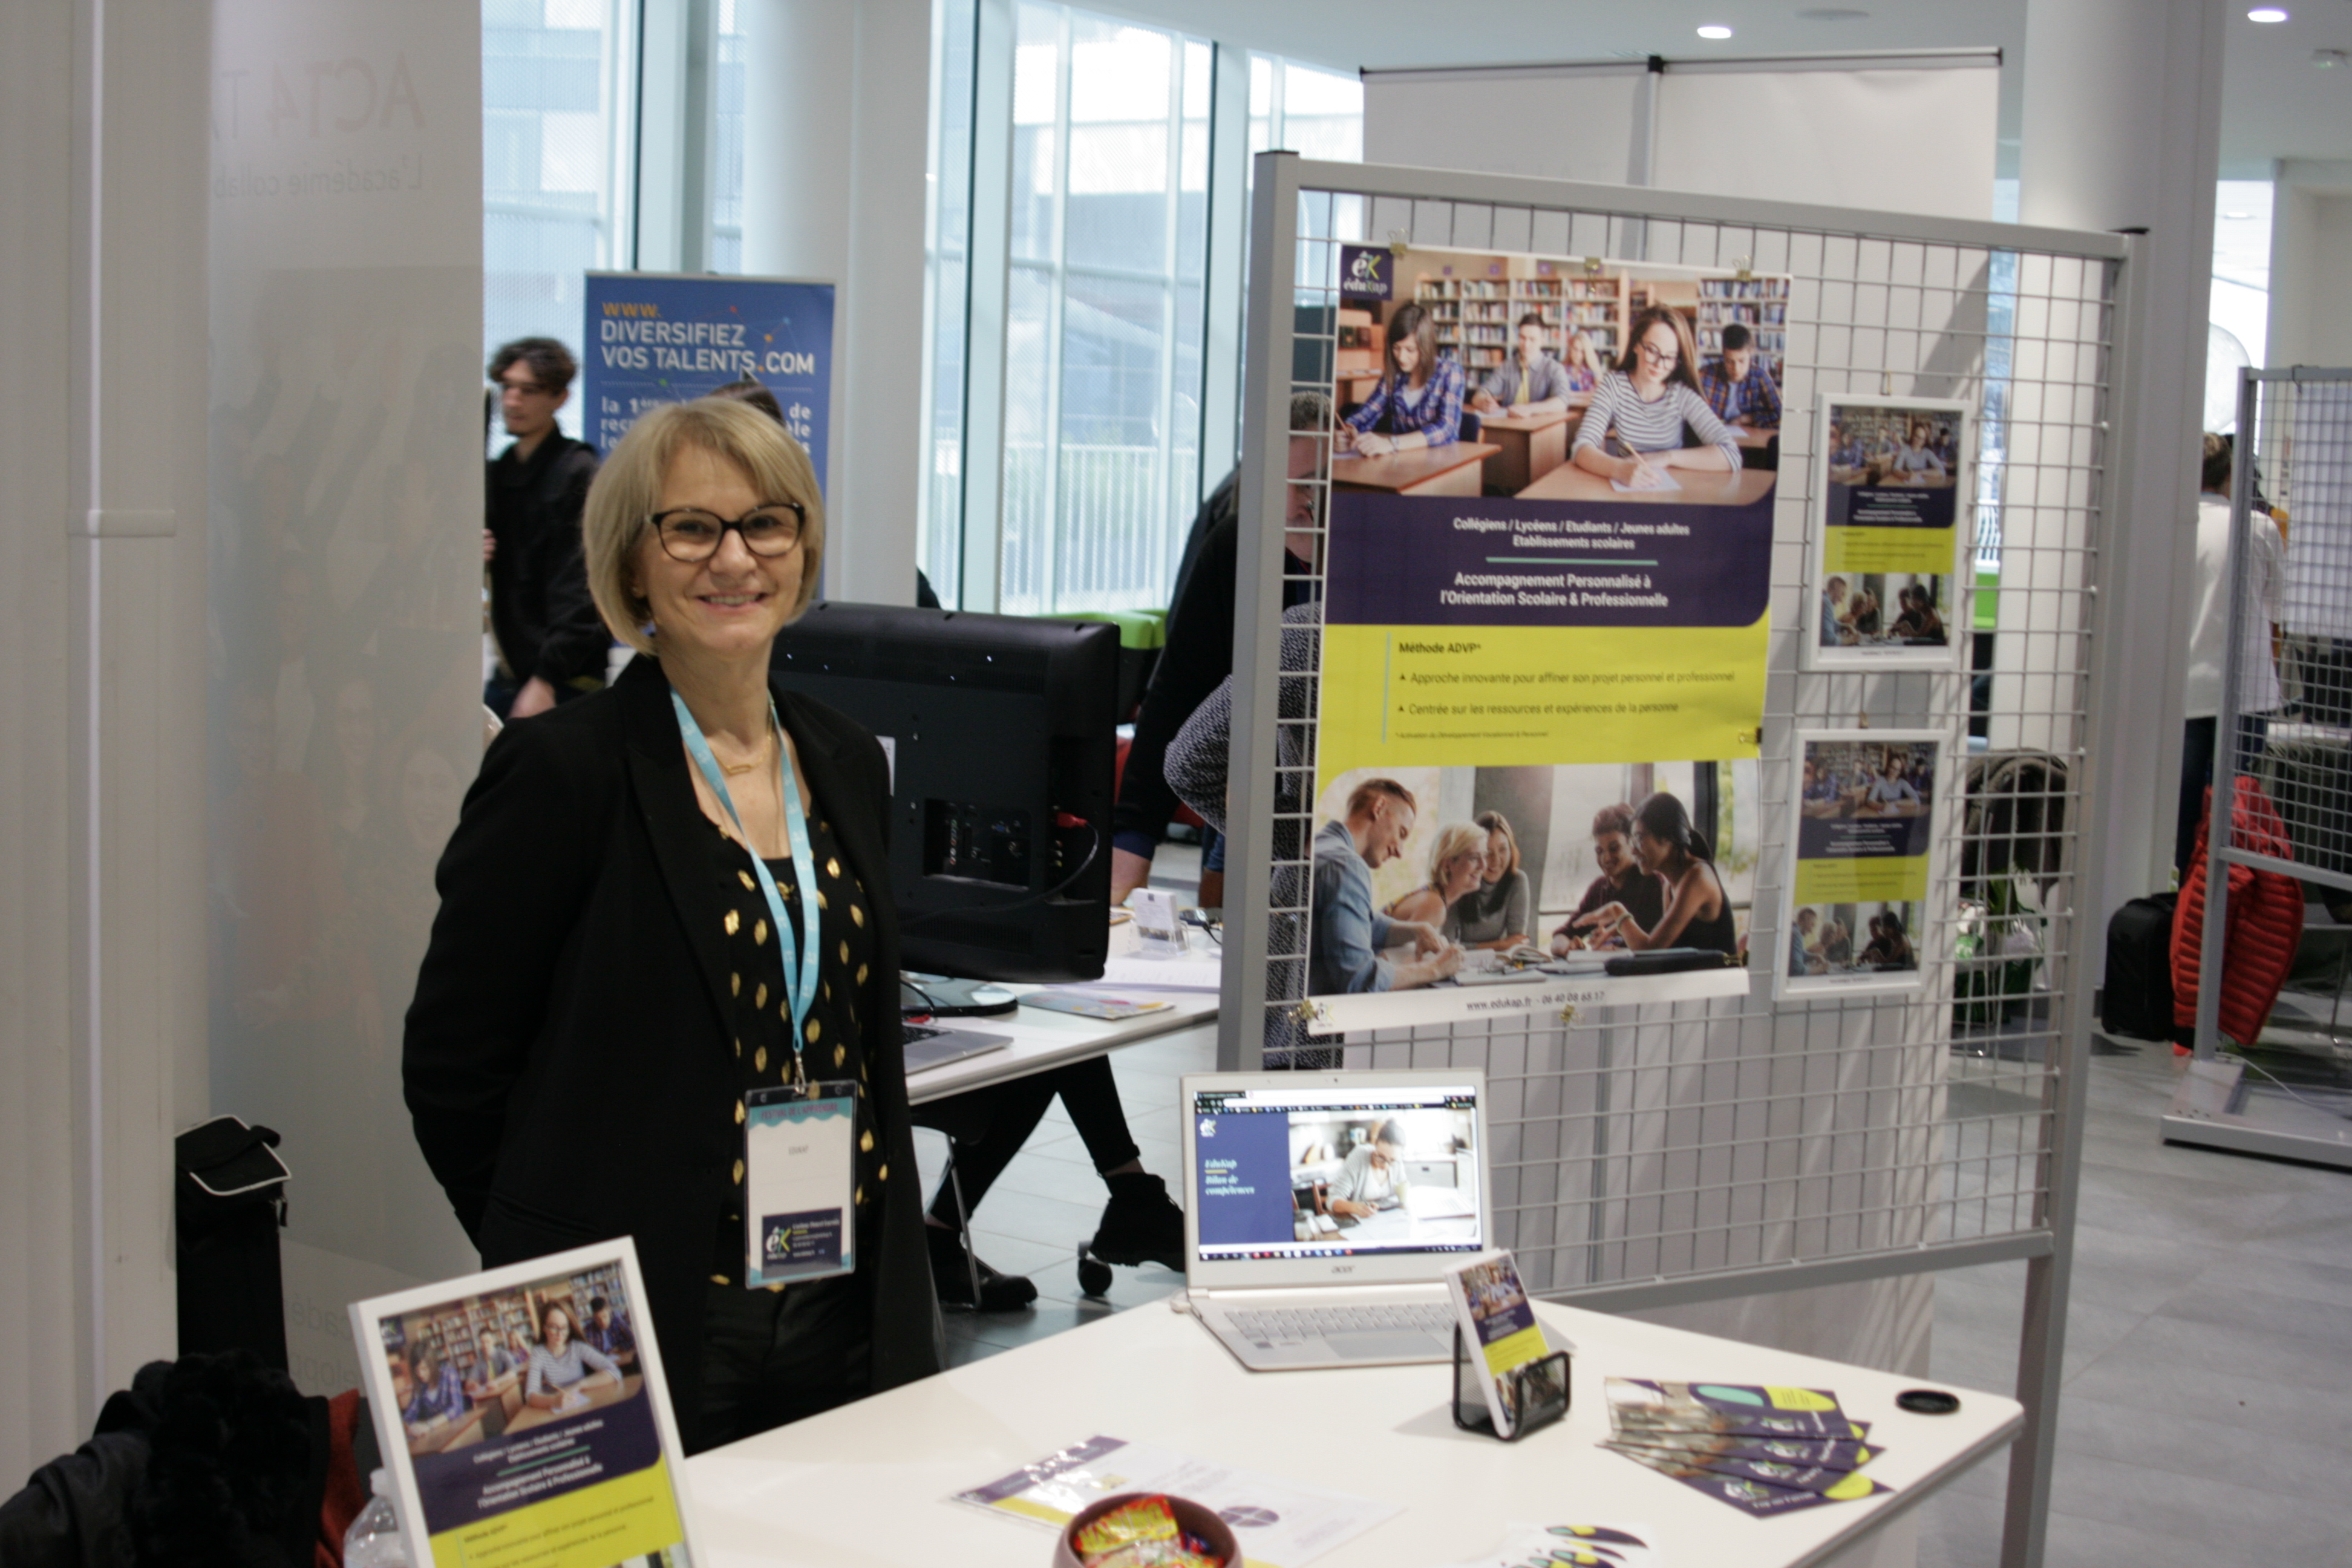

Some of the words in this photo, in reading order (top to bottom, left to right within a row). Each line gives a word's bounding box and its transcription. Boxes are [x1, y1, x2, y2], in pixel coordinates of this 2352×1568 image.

[601, 319, 746, 347] DIVERSIFIEZ
[601, 345, 648, 370] VOS
[601, 396, 621, 414] la
[788, 402, 812, 420] de
[1453, 517, 1508, 533] Collégiens
[1515, 518, 1558, 534] Lycéens
[1566, 520, 1613, 534] Etudiants
[1619, 521, 1655, 535] Jeunes
[1656, 522, 1691, 536] adultes
[1513, 534, 1590, 549] Etablissements
[1591, 537, 1636, 550] scolaires
[1454, 571, 1566, 590] Accompagnement
[1566, 573, 1642, 590] Personnalisé
[1643, 573, 1651, 589] à
[1440, 589, 1516, 606] l'Orientation
[1517, 590, 1567, 606] Scolaire
[1569, 591, 1579, 606] &
[1580, 591, 1669, 607] Professionnelle
[1398, 642, 1445, 654] Méthode
[1410, 671, 1460, 685] Approche
[1462, 672, 1511, 684] innovante
[1513, 673, 1535, 685] pour
[1538, 671, 1569, 684] affiner
[1572, 674, 1590, 683] son
[1592, 673, 1618, 685] projet
[1620, 671, 1664, 685] personnel
[1665, 672, 1675, 682] et
[1676, 670, 1735, 684] professionnel
[1330, 1264, 1356, 1275] acer
